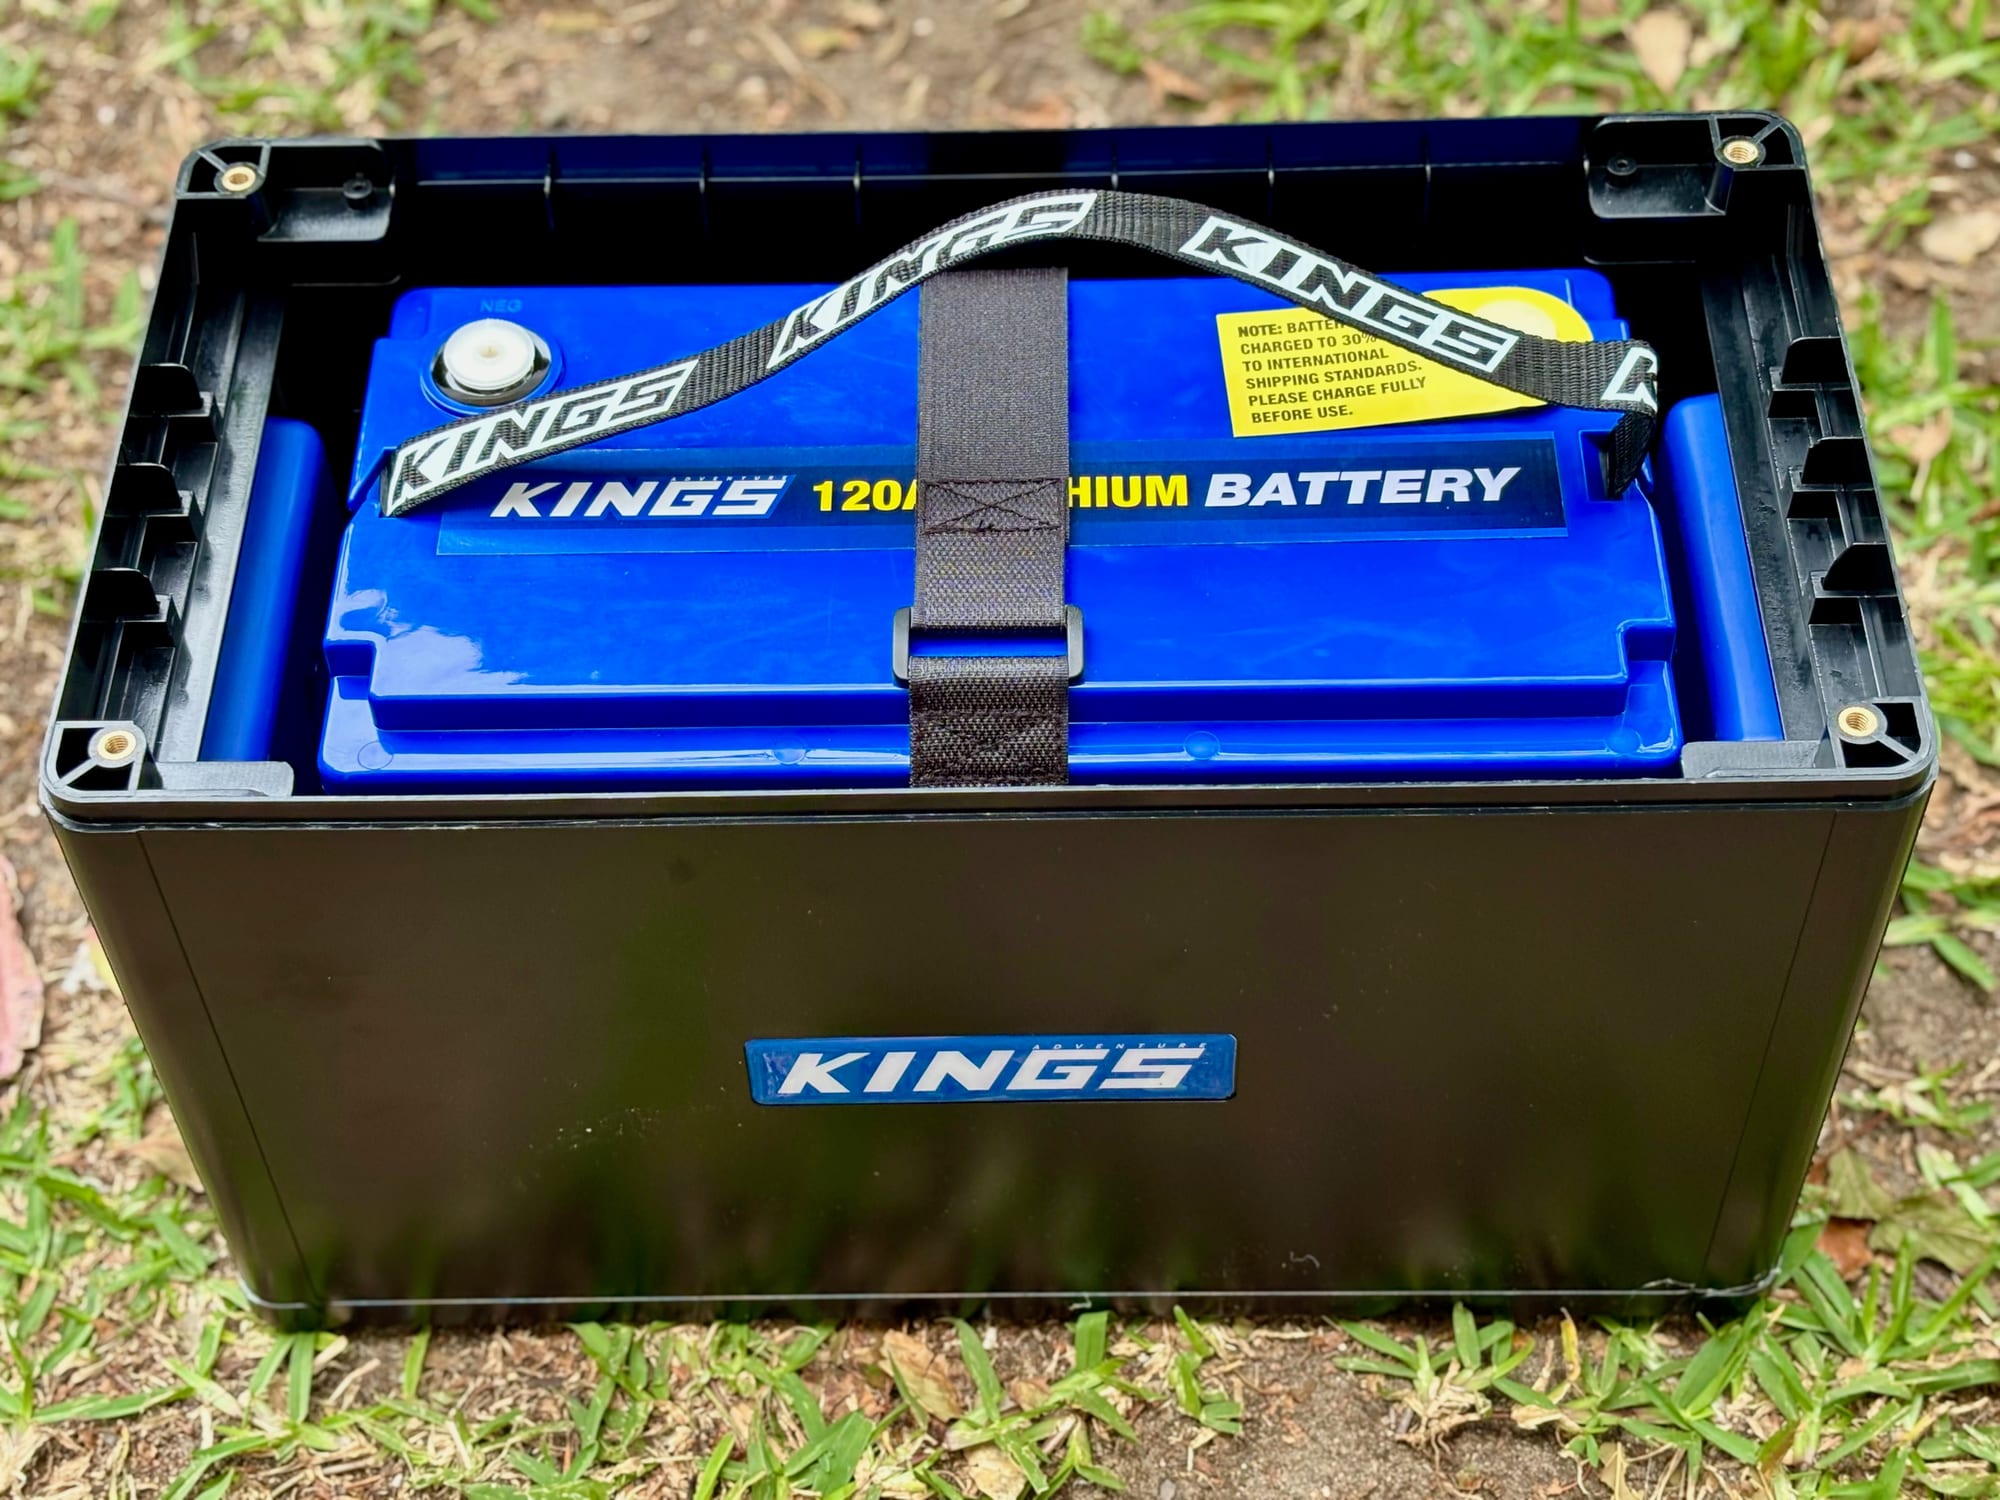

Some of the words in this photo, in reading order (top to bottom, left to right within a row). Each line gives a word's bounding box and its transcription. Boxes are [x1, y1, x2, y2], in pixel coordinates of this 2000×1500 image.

[1179, 215, 1519, 373] KINGS
[1238, 324, 1282, 338] NOTE:
[1241, 337, 1313, 355] CHARGED
[1318, 335, 1337, 348] TO
[1342, 332, 1377, 346] 30%
[1243, 361, 1262, 372] TO
[1267, 348, 1389, 370] INTERNATIONAL
[1246, 373, 1319, 389] SHIPPING
[1324, 361, 1422, 382] STANDARDS.
[1249, 390, 1308, 406] PLEASE
[1312, 385, 1377, 402] CHARGE
[1381, 376, 1426, 394] FULLY
[1252, 408, 1313, 424] BEFORE
[1318, 405, 1353, 418] USE.
[388, 359, 699, 516] KINGS
[490, 480, 787, 518] KINGS
[813, 479, 918, 512] 120
[1068, 475, 1188, 507] HIUM
[1204, 467, 1521, 507] BATTERY
[1032, 1042, 1207, 1050] ADVENTURE
[777, 1048, 1206, 1094] KINGS
